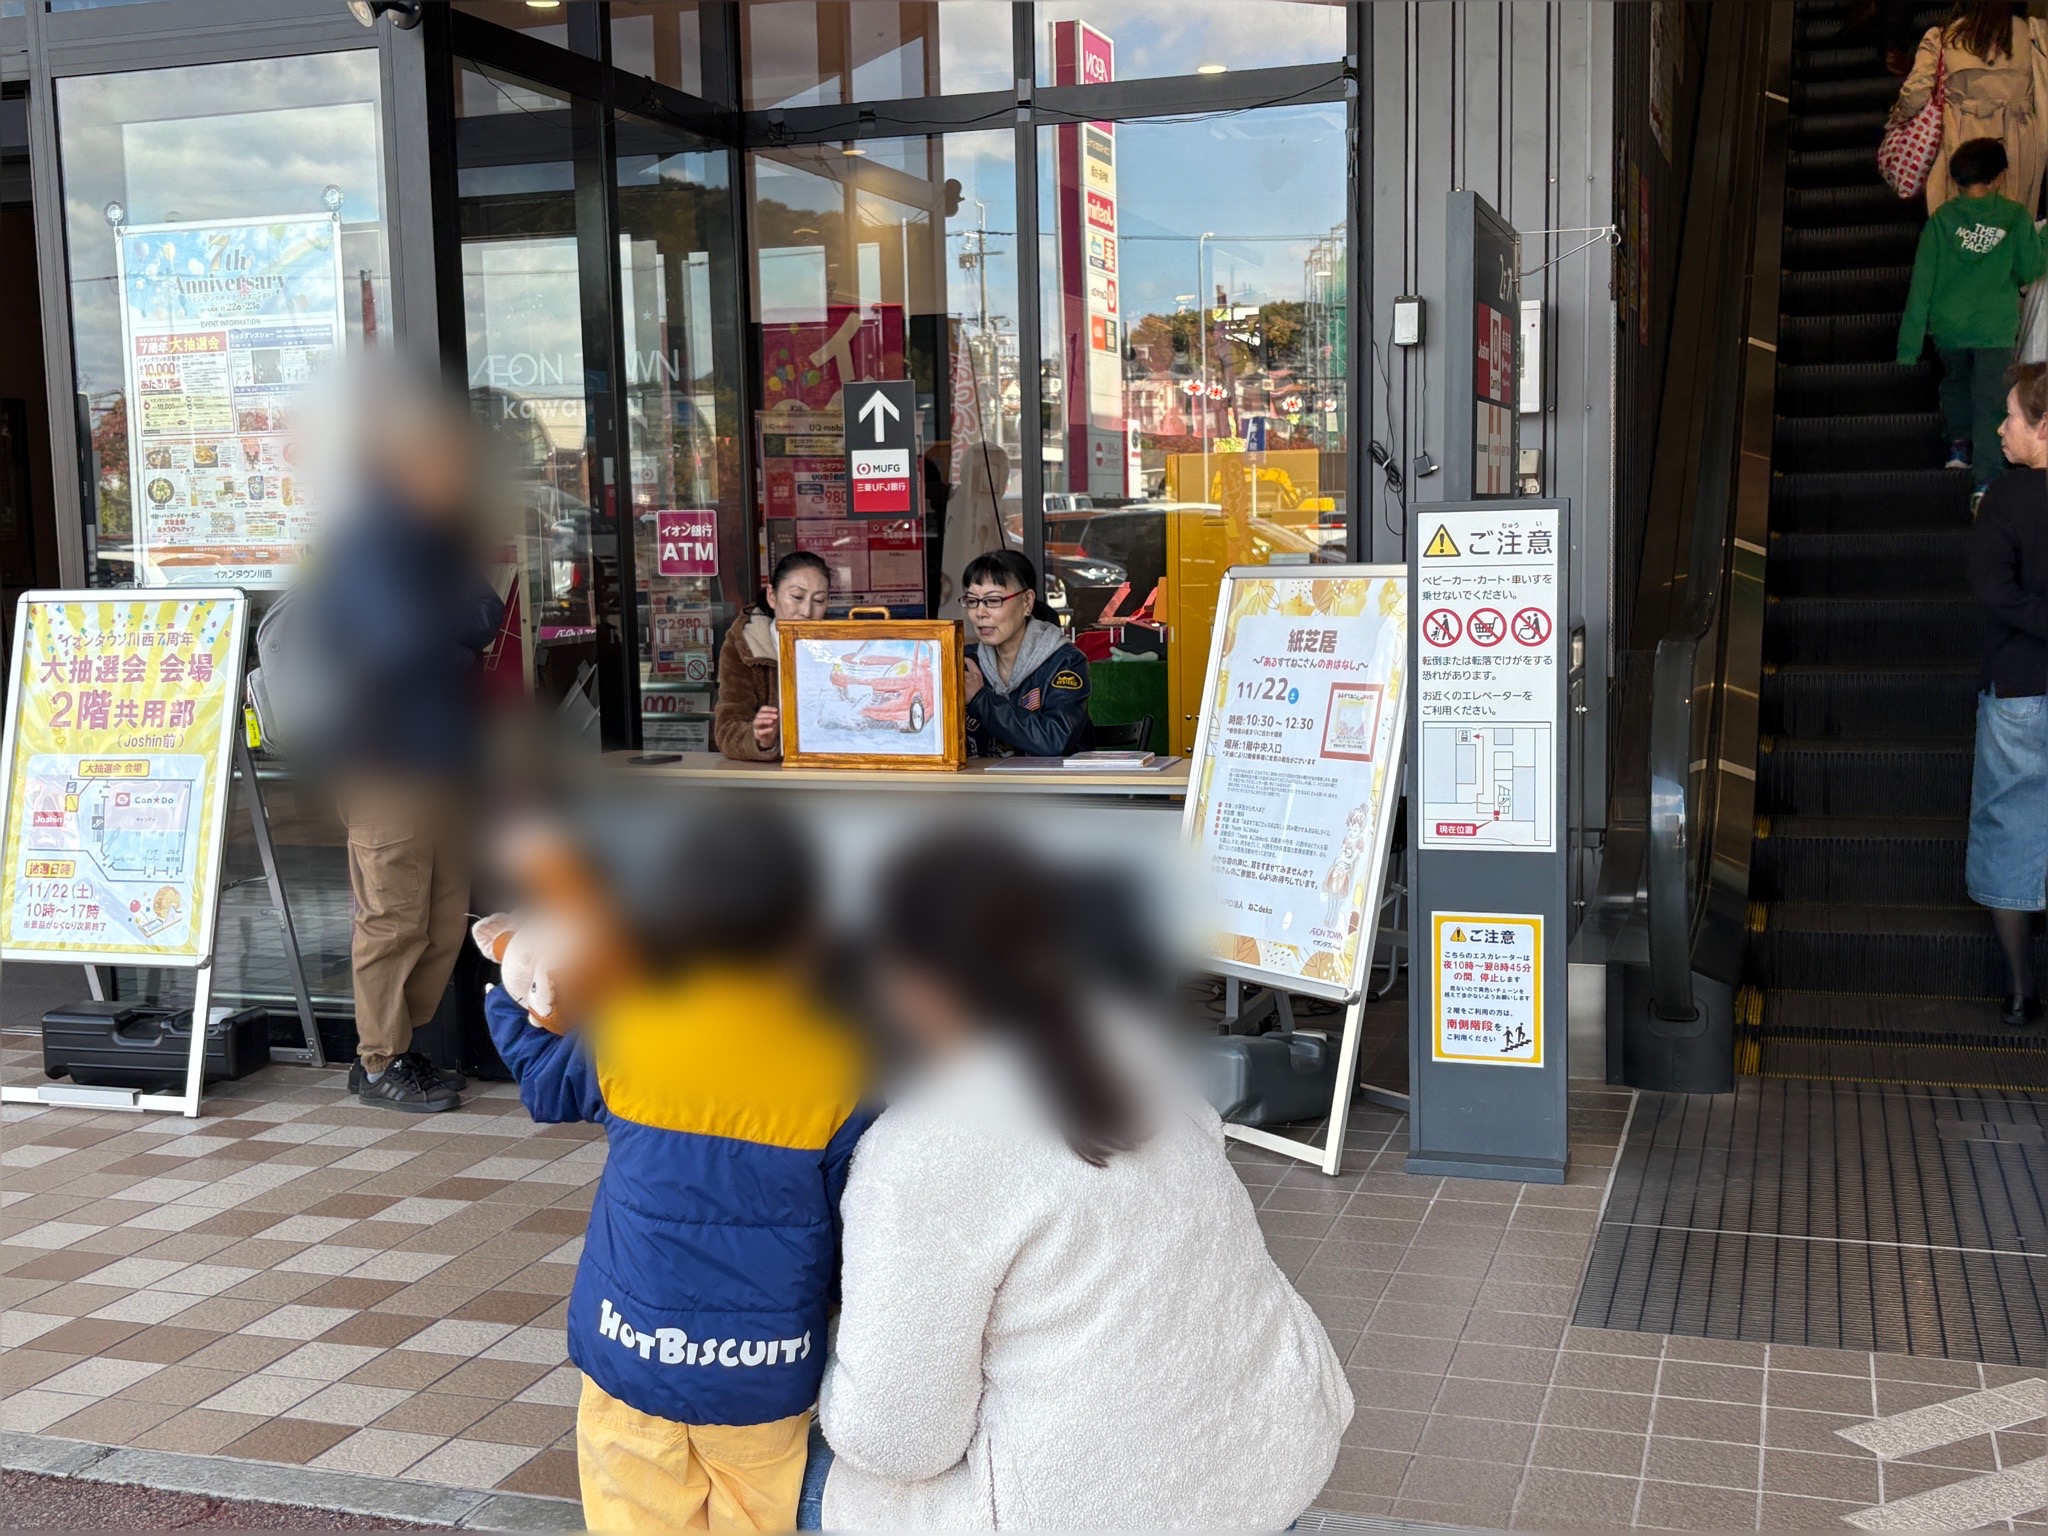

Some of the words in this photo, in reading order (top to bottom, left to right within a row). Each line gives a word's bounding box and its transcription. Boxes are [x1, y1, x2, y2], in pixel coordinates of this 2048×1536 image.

[1955, 227, 1993, 246] NORTH
[1975, 223, 1997, 237] THE
[1961, 239, 1992, 254] FACE
[173, 273, 287, 294] Anniversary
[201, 320, 219, 328] EVENT
[220, 318, 261, 327] INFORMATION
[873, 464, 901, 473] MUFG
[857, 483, 906, 492] 三菱UFJ銀行
[661, 525, 713, 538] イオン銀行
[1469, 530, 1553, 555] ご注意
[663, 542, 714, 561] ATM
[214, 569, 273, 579] イオンタウン川西
[1422, 573, 1552, 586] ベビーカー・カート・車いすを
[1422, 590, 1517, 601] 乗せないでください。
[60, 631, 194, 648] イオンタウン川西7周年
[1287, 629, 1338, 654] 紙芝居
[1422, 655, 1553, 666] 転倒または転落でけがをする
[40, 654, 148, 684] 大抽選会
[159, 653, 214, 684] 会場
[1422, 671, 1498, 681] 恐れがあります。
[1237, 677, 1289, 701] 11/22
[1422, 690, 1533, 701] お近くのエレベーターを
[49, 690, 196, 730] 2階共用部
[1422, 705, 1497, 716] ご利用ください。
[85, 763, 122, 774] 大抽選会
[125, 763, 143, 773] 会場
[35, 814, 63, 824] Joshin
[1439, 825, 1474, 835] 現在位置
[29, 862, 72, 875] 抽選日時
[1469, 929, 1515, 944] ご注意
[1444, 951, 1530, 961] こちらのエスカレーターは
[1453, 972, 1521, 983] の間、停止します
[1446, 1019, 1502, 1032] 南側階段を
[1446, 1034, 1496, 1042] ご利用ください
